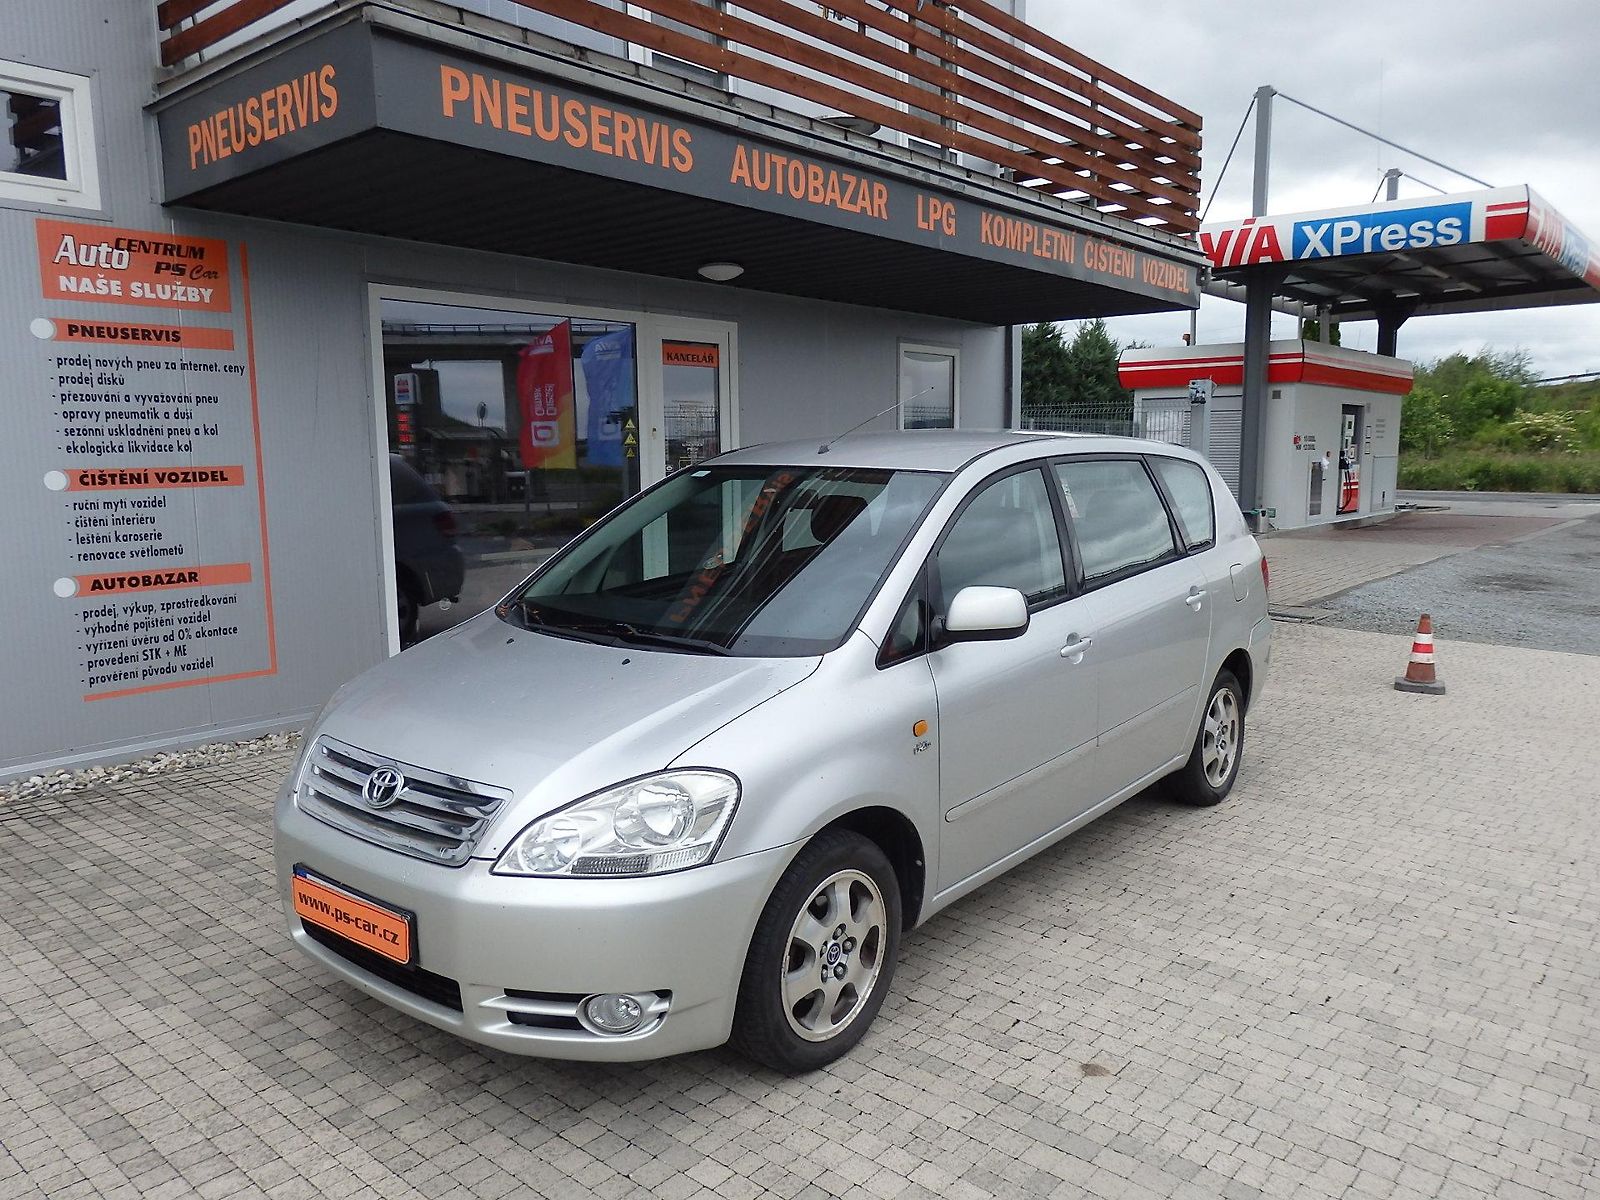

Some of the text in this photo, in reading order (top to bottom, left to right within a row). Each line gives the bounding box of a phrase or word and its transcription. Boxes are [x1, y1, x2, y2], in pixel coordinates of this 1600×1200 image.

[188, 64, 338, 171] PNEUSERVIS
[440, 64, 694, 174] PNEUSERVIS
[730, 144, 889, 220] AUTOBAZAR
[917, 194, 957, 238] LPG
[981, 211, 1076, 265] KOMPLETNÍ
[1141, 256, 1190, 294] VOZIDEL
[1301, 216, 1465, 259] XPress
[53, 234, 205, 270] Auto CENTRUM
[154, 261, 220, 280] PS Car
[59, 274, 214, 304] NAŠE SLUŽBY
[67, 324, 181, 342] PNEUSERVIS
[57, 354, 92, 369] prodej
[95, 356, 133, 370] nových
[137, 360, 161, 371] pneu
[164, 361, 176, 370] za
[223, 363, 245, 376] ceny
[58, 372, 94, 387] prodej
[124, 394, 131, 402] a
[195, 395, 219, 406] pneu
[62, 410, 101, 422] opravy
[105, 408, 159, 421] pneumatik
[163, 411, 170, 420] a
[167, 427, 191, 438] pneu
[194, 427, 200, 436] a
[203, 424, 219, 436] kol
[128, 440, 174, 453] likvidace
[177, 440, 193, 453] kol
[79, 469, 229, 487] ČIŠTĚNÍ VOZIDEL
[131, 496, 167, 508] vozidel
[112, 513, 156, 526] interiéru
[115, 529, 163, 543] karoserie
[77, 550, 126, 562] renovace
[90, 571, 199, 592] AUTOBAZAR
[82, 604, 119, 622] prodej,
[122, 602, 157, 617] výkup,
[177, 610, 211, 625] vozidel
[163, 630, 175, 643] od
[178, 628, 193, 641] 0%
[195, 626, 238, 639] akontace
[87, 653, 139, 671] provedení
[142, 647, 162, 661] STK
[174, 644, 188, 657] ME
[181, 656, 215, 672] vozidel
[299, 892, 400, 945] www.ps-car.cz
